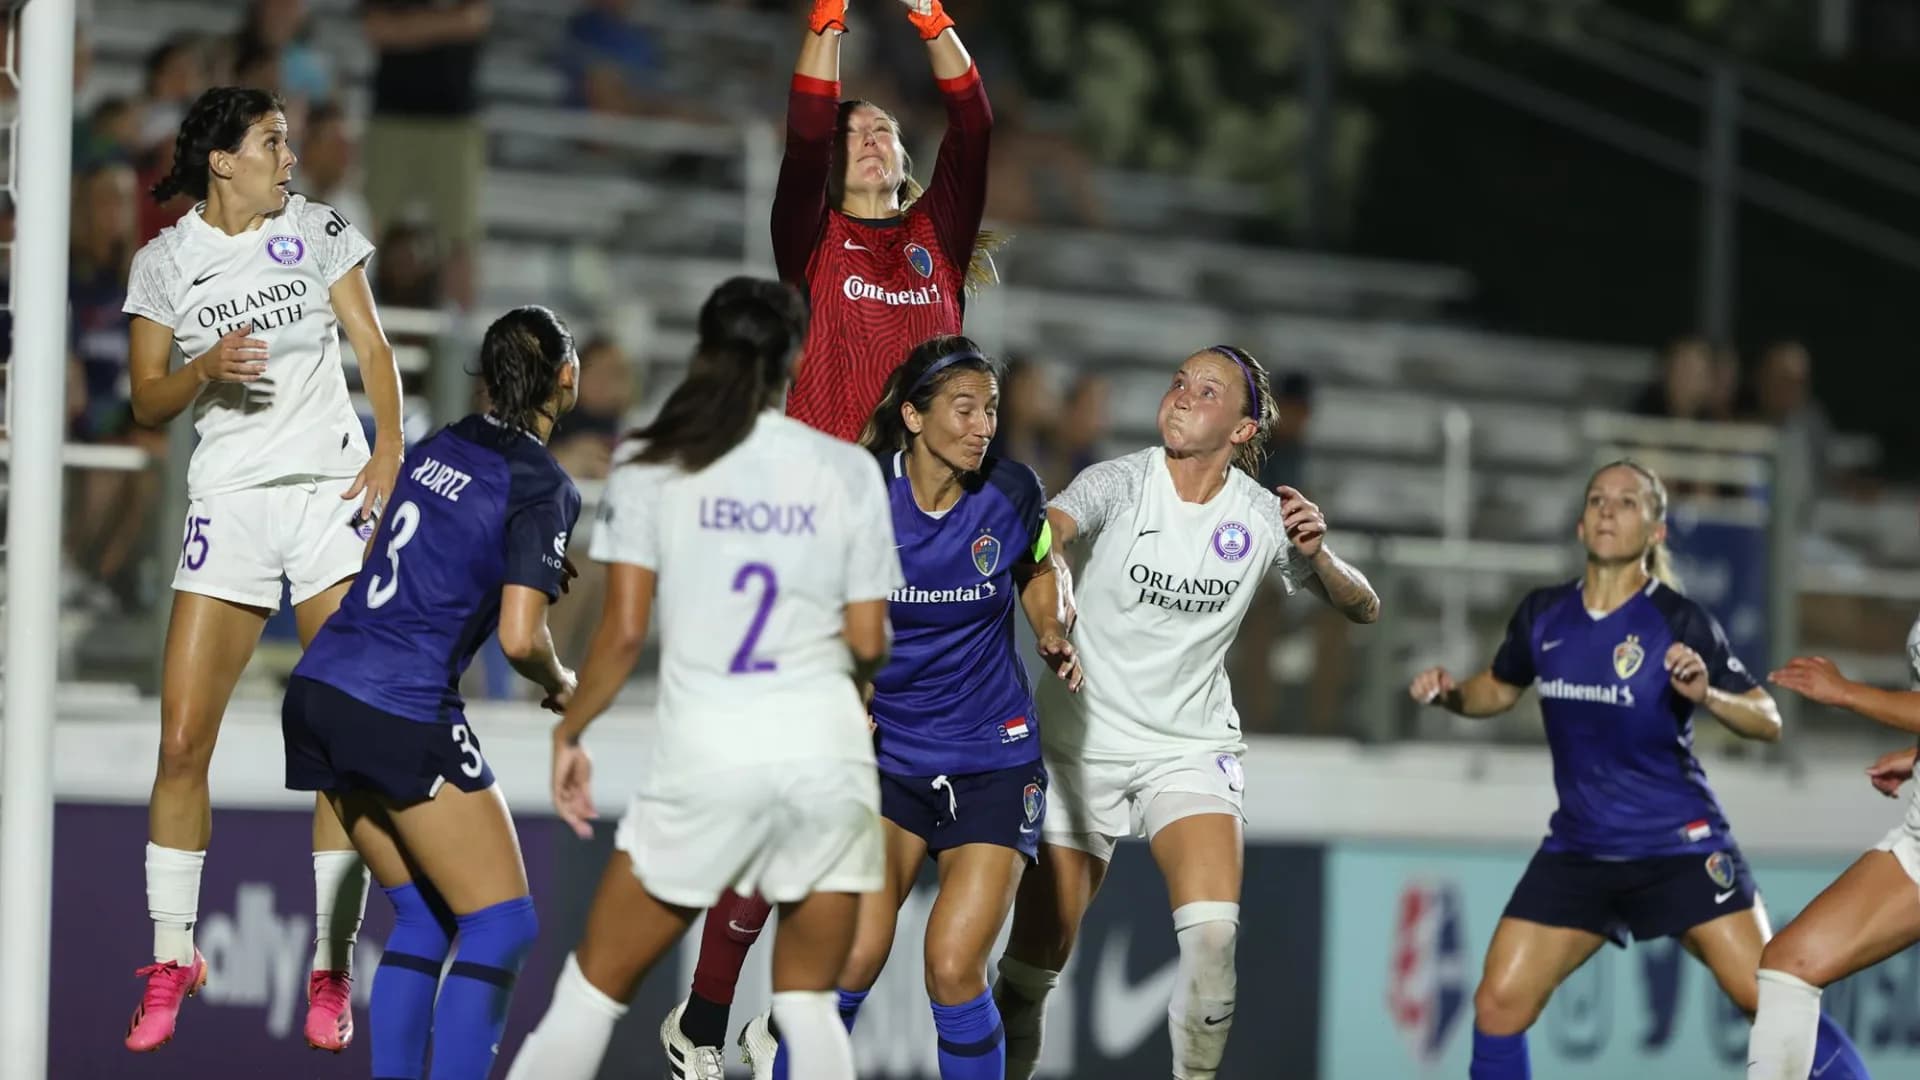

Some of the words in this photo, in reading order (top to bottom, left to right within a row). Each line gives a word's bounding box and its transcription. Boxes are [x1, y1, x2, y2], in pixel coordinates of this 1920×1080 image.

[198, 279, 307, 328] ORLANDO
[843, 275, 931, 305] Contnetal
[410, 456, 472, 502] KURTZ
[699, 498, 816, 535] LEROUX
[181, 516, 211, 571] 15
[367, 501, 420, 609] 3
[1129, 564, 1240, 596] ORLANDO
[1139, 588, 1227, 613] HEALTH
[728, 561, 778, 674] 2
[452, 724, 482, 778] 3
